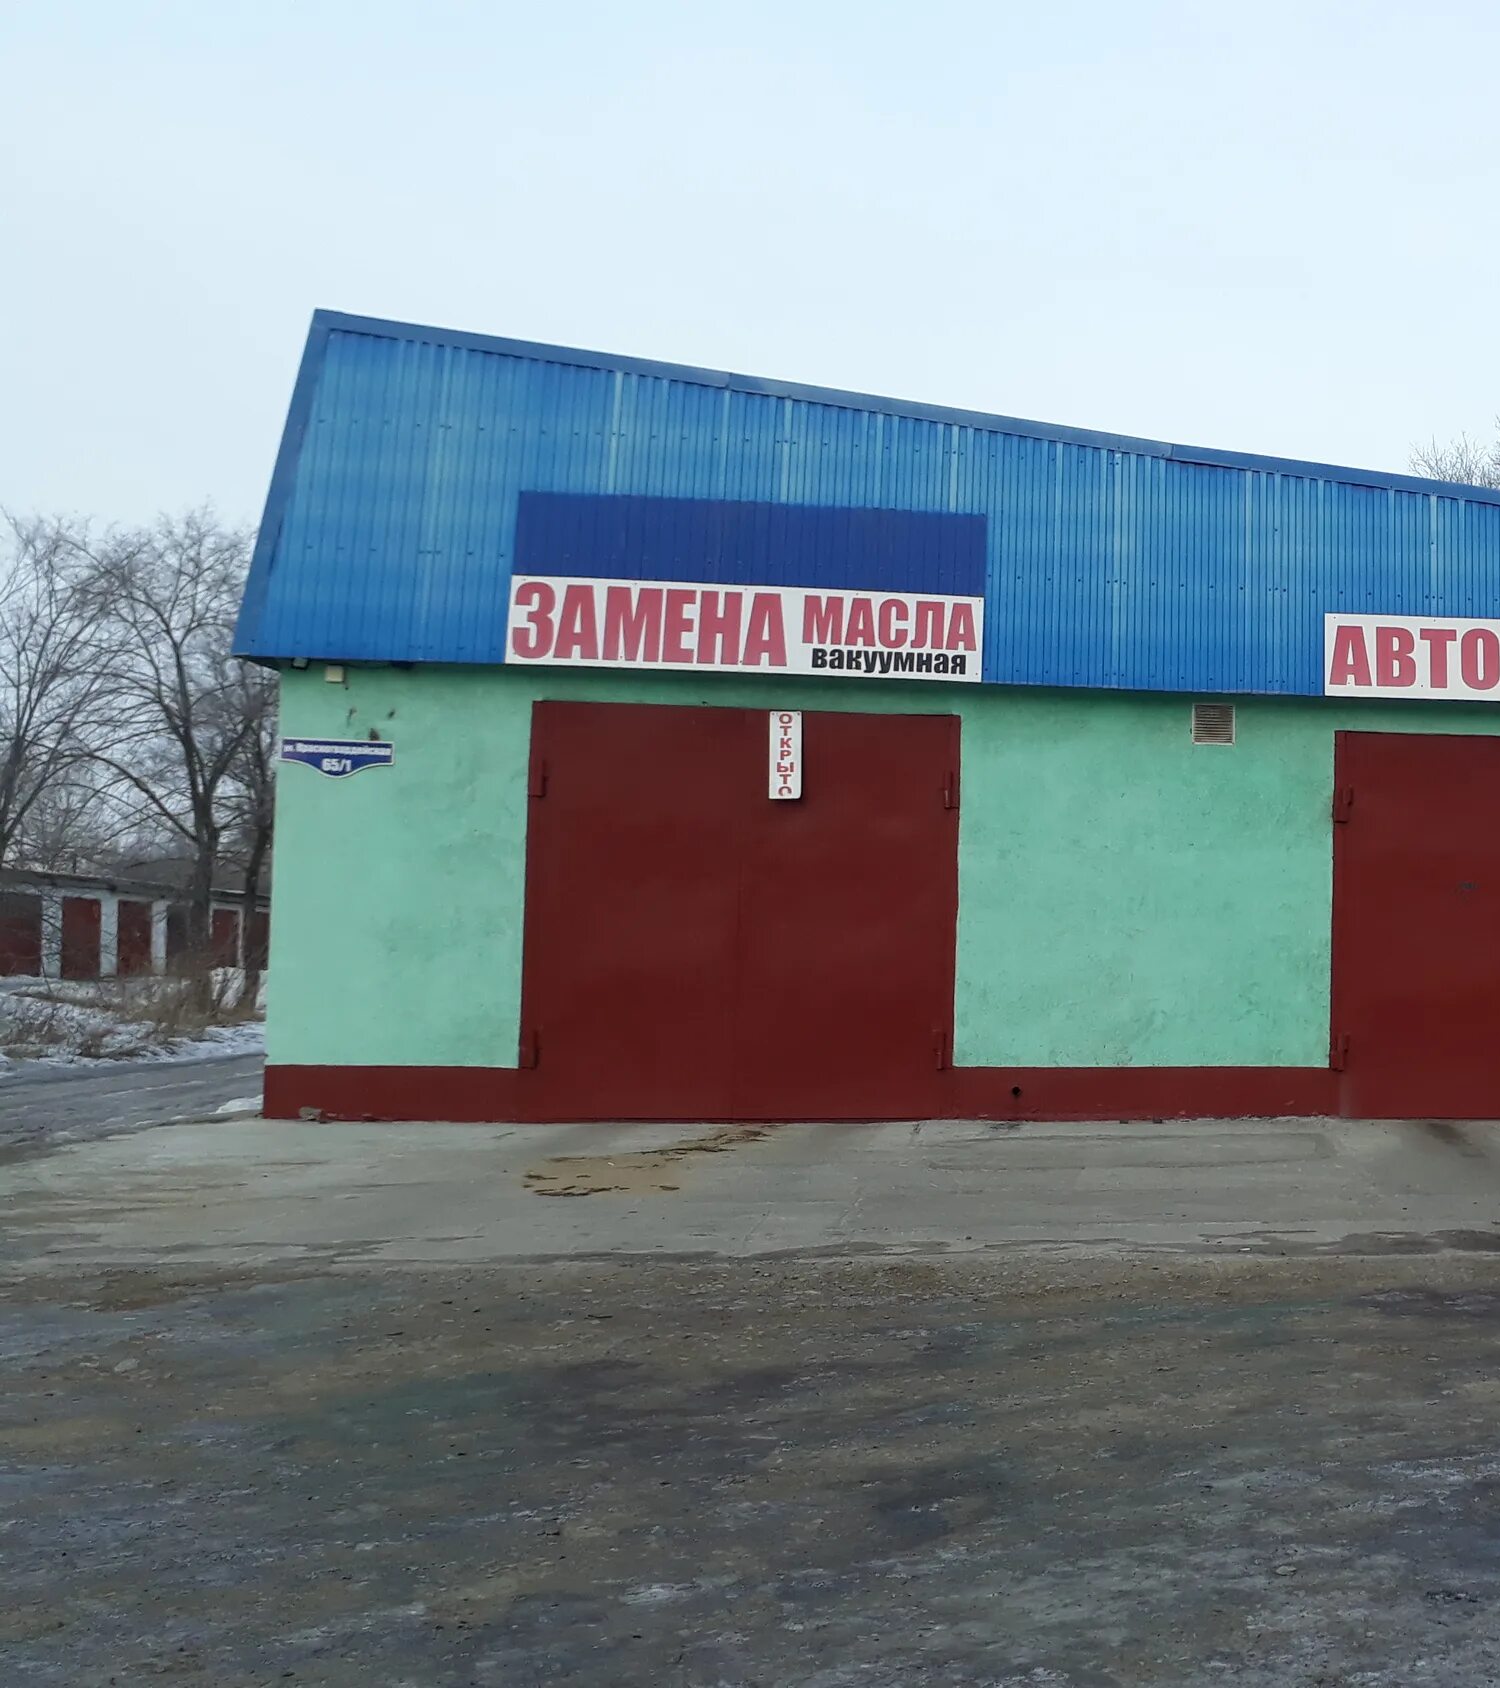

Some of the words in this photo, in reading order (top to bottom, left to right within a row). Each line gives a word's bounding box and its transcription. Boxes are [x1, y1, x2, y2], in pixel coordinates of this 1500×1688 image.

[511, 581, 788, 667] ЗАМЕНА
[801, 595, 978, 651] МАСЛА
[811, 648, 967, 675] вакуумная
[321, 758, 352, 772] 65/1
[776, 713, 795, 797] ОТКРЫТО
